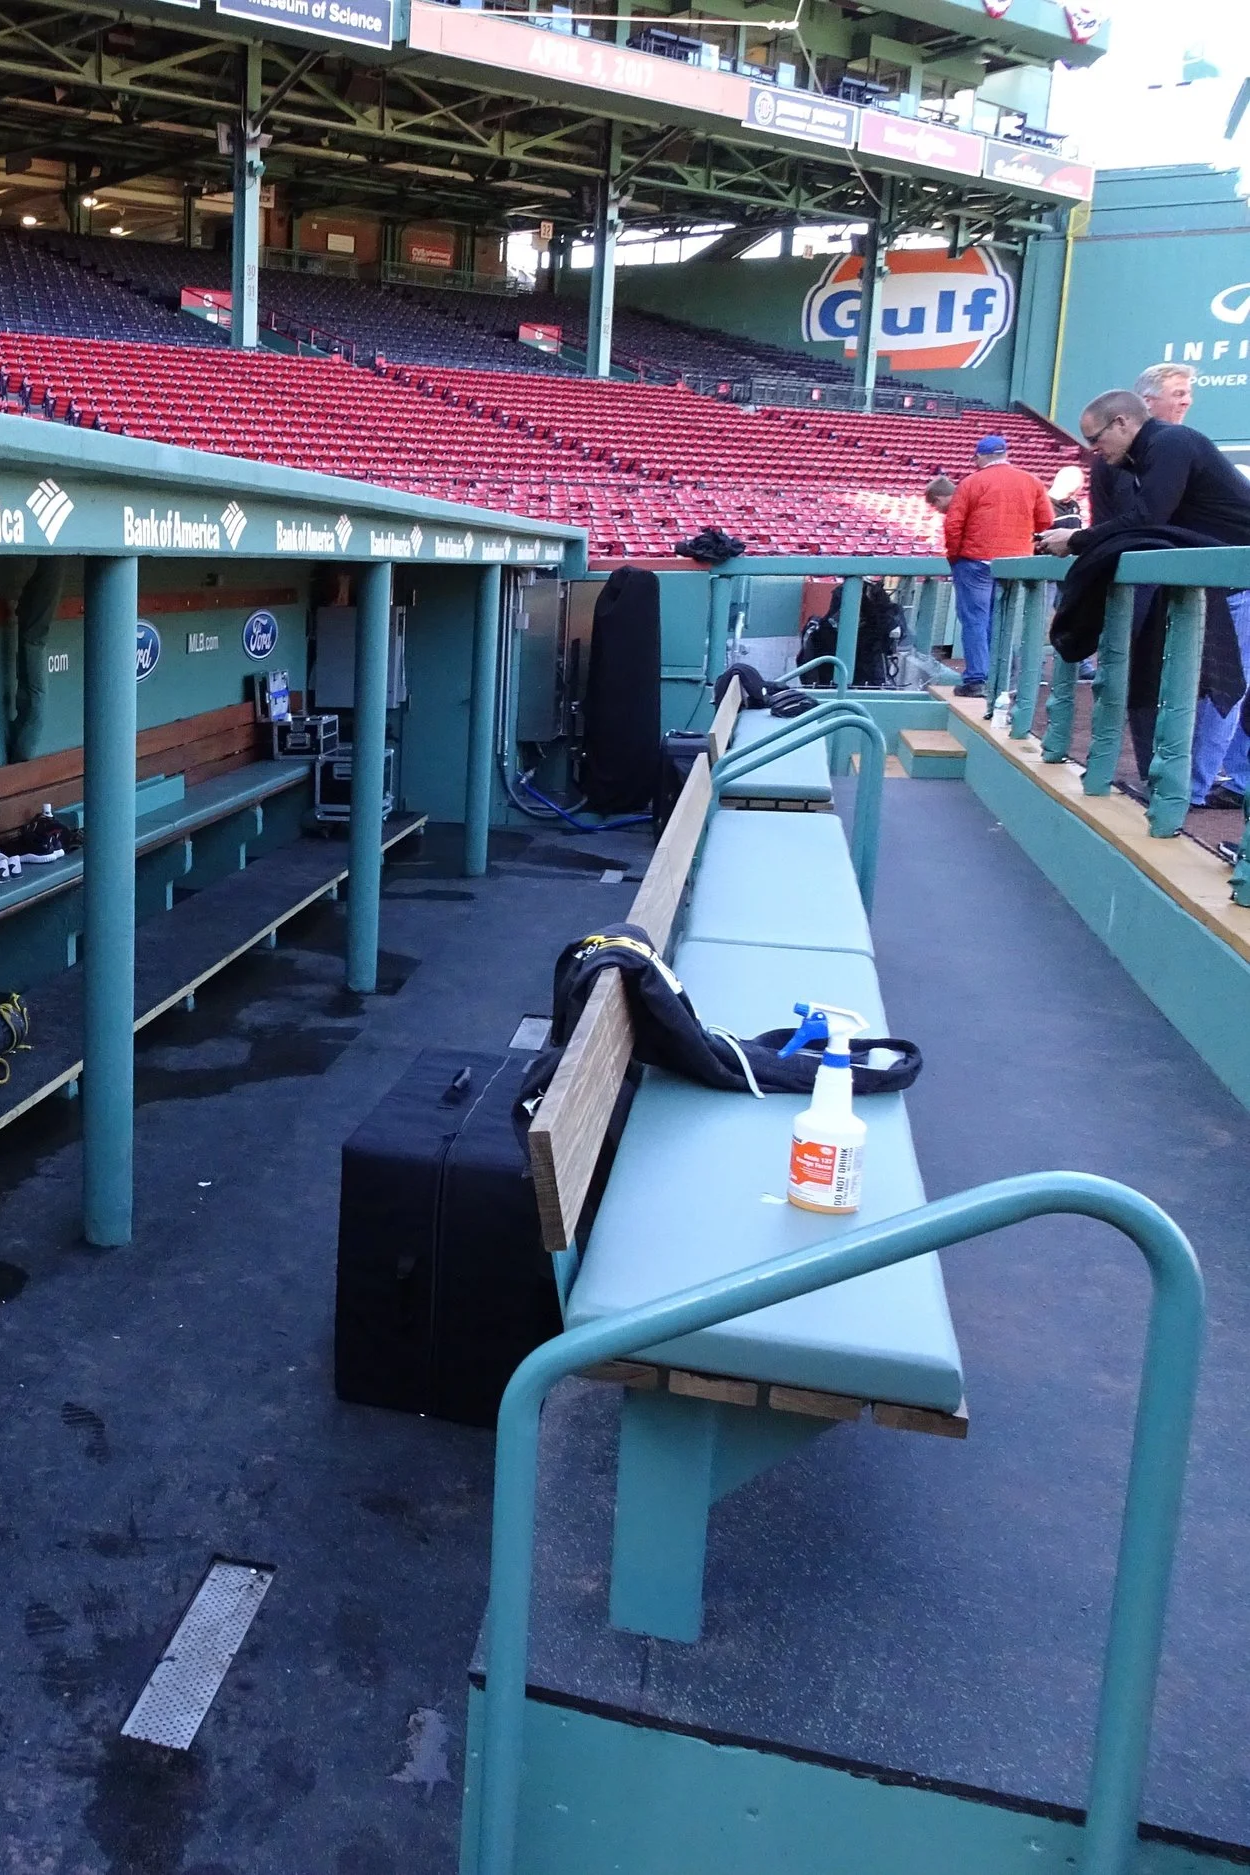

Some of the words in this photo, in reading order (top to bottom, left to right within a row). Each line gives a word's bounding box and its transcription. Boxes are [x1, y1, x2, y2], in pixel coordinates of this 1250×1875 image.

[311, 2, 326, 19] of
[329, 4, 382, 32] Science
[528, 36, 582, 74] APRIL
[614, 57, 654, 88] 2017
[819, 288, 997, 337] Gulf
[1190, 374, 1247, 387] POWER
[124, 506, 158, 547] Bank
[159, 510, 172, 548] of
[173, 511, 220, 550] America
[276, 520, 297, 551] Bank
[306, 523, 335, 552] America
[188, 633, 219, 654] MLB.com
[250, 617, 272, 653] Ford
[838, 1148, 849, 1173] DRINK
[836, 1177, 846, 1192] NOT
[834, 1194, 843, 1206] DO
